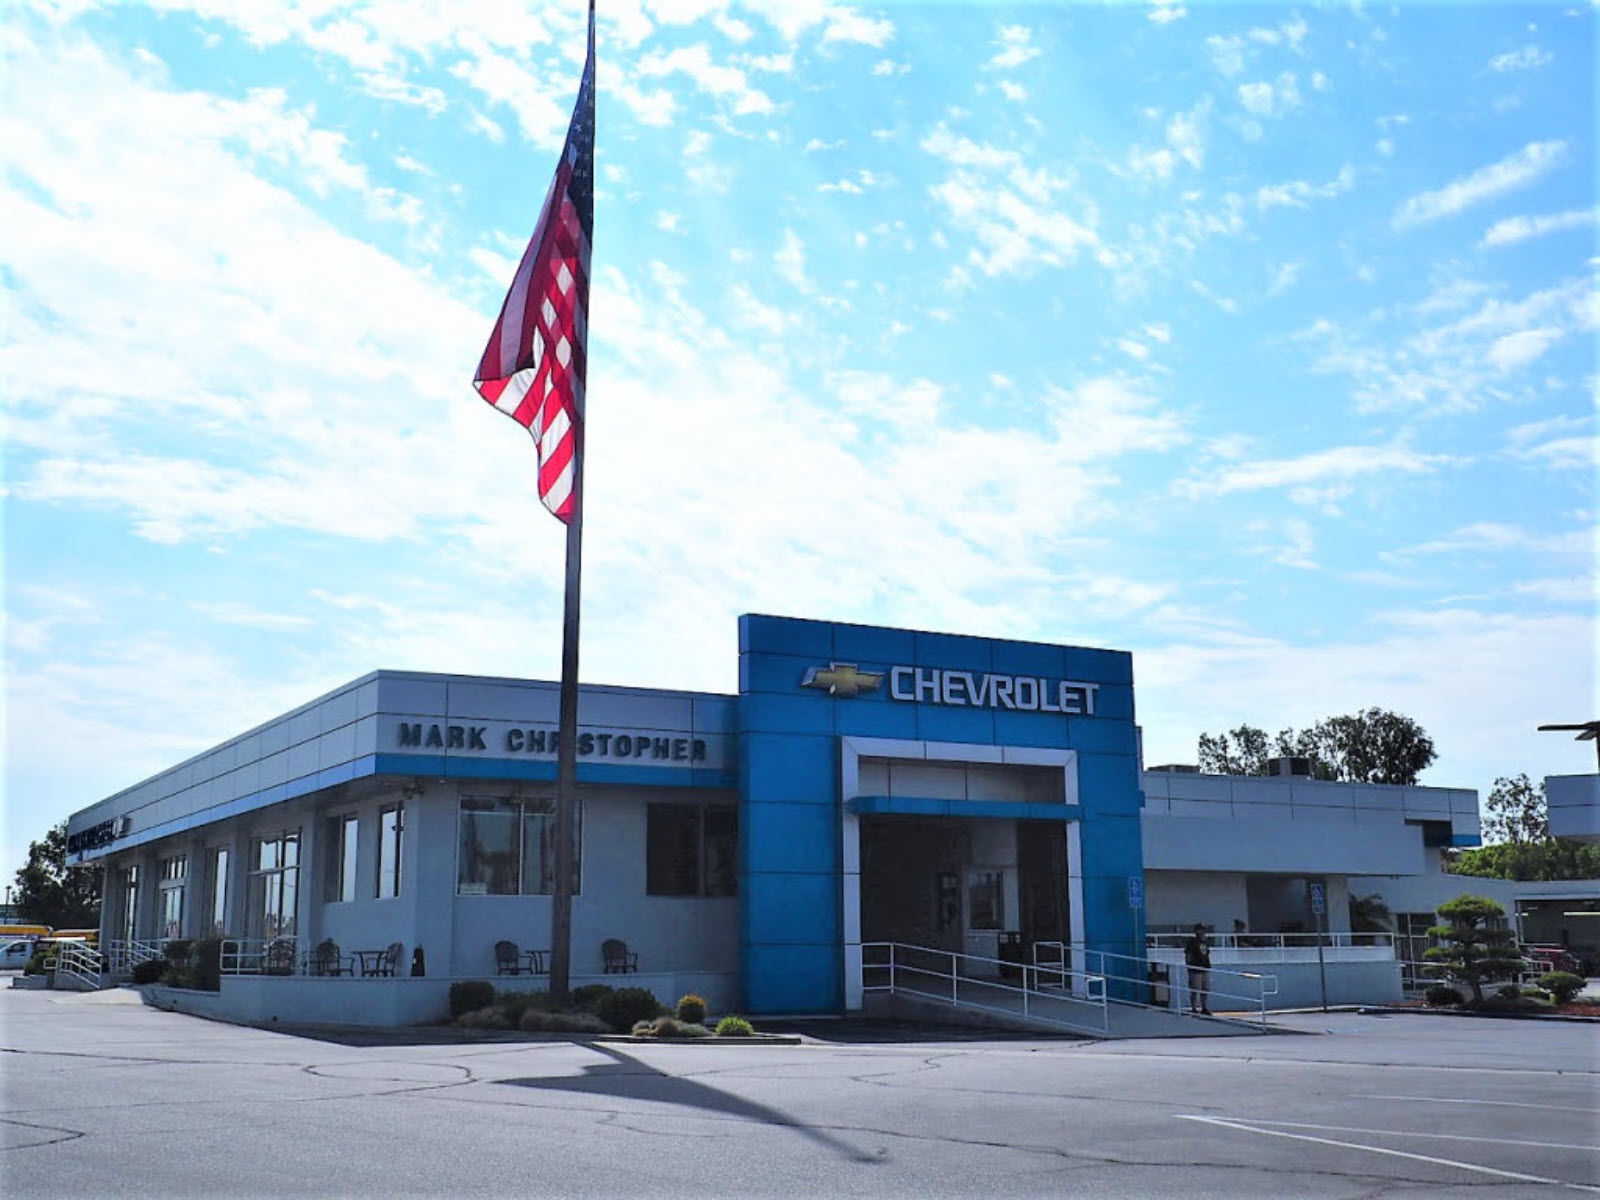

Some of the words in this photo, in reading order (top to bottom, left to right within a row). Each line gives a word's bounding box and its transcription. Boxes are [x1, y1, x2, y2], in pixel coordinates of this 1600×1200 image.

[890, 665, 1100, 715] CHEVROLET
[398, 722, 487, 750] MARK
[506, 728, 706, 761] CHRSTOPHER
